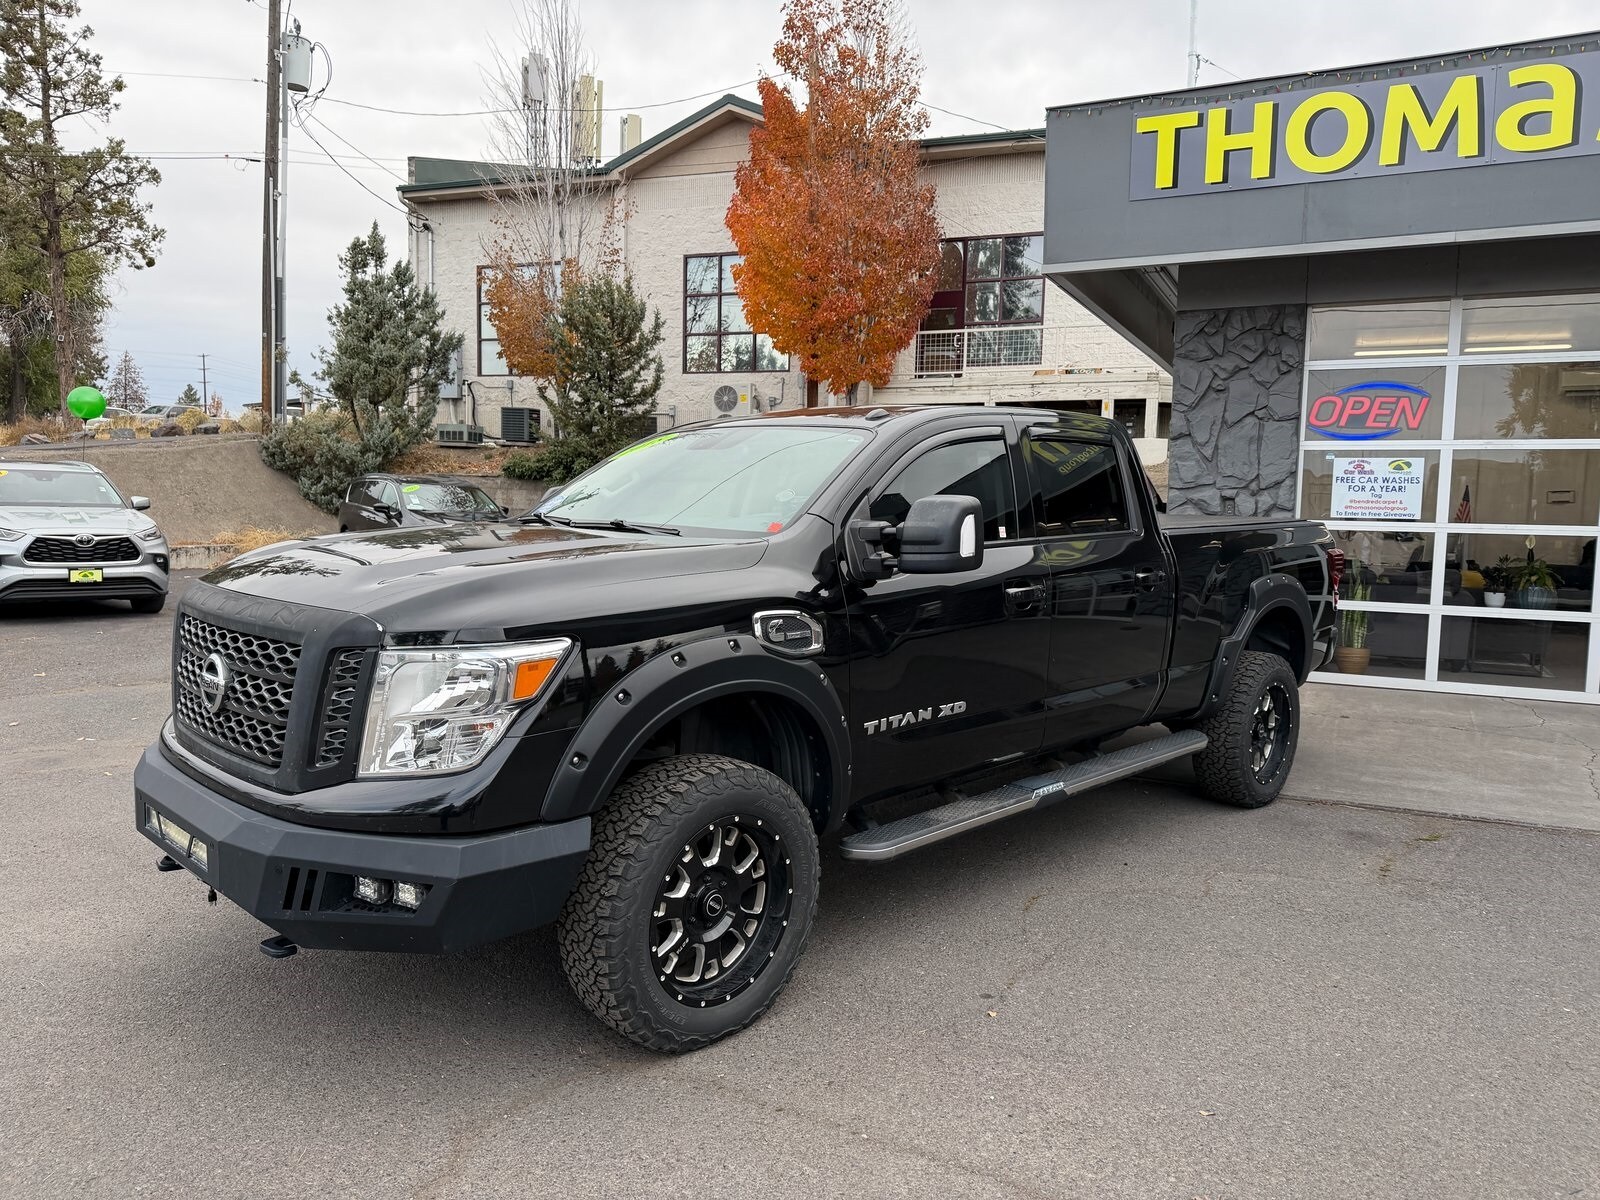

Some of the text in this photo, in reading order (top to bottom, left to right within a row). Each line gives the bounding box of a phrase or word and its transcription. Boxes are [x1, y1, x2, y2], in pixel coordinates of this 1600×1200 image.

[1137, 63, 1600, 189] THOMa
[1308, 395, 1431, 429] OPEN
[1335, 476, 1421, 485] FREE CAR WASHES
[1379, 485, 1407, 493] YEAR!
[863, 700, 967, 736] TITAN XD
